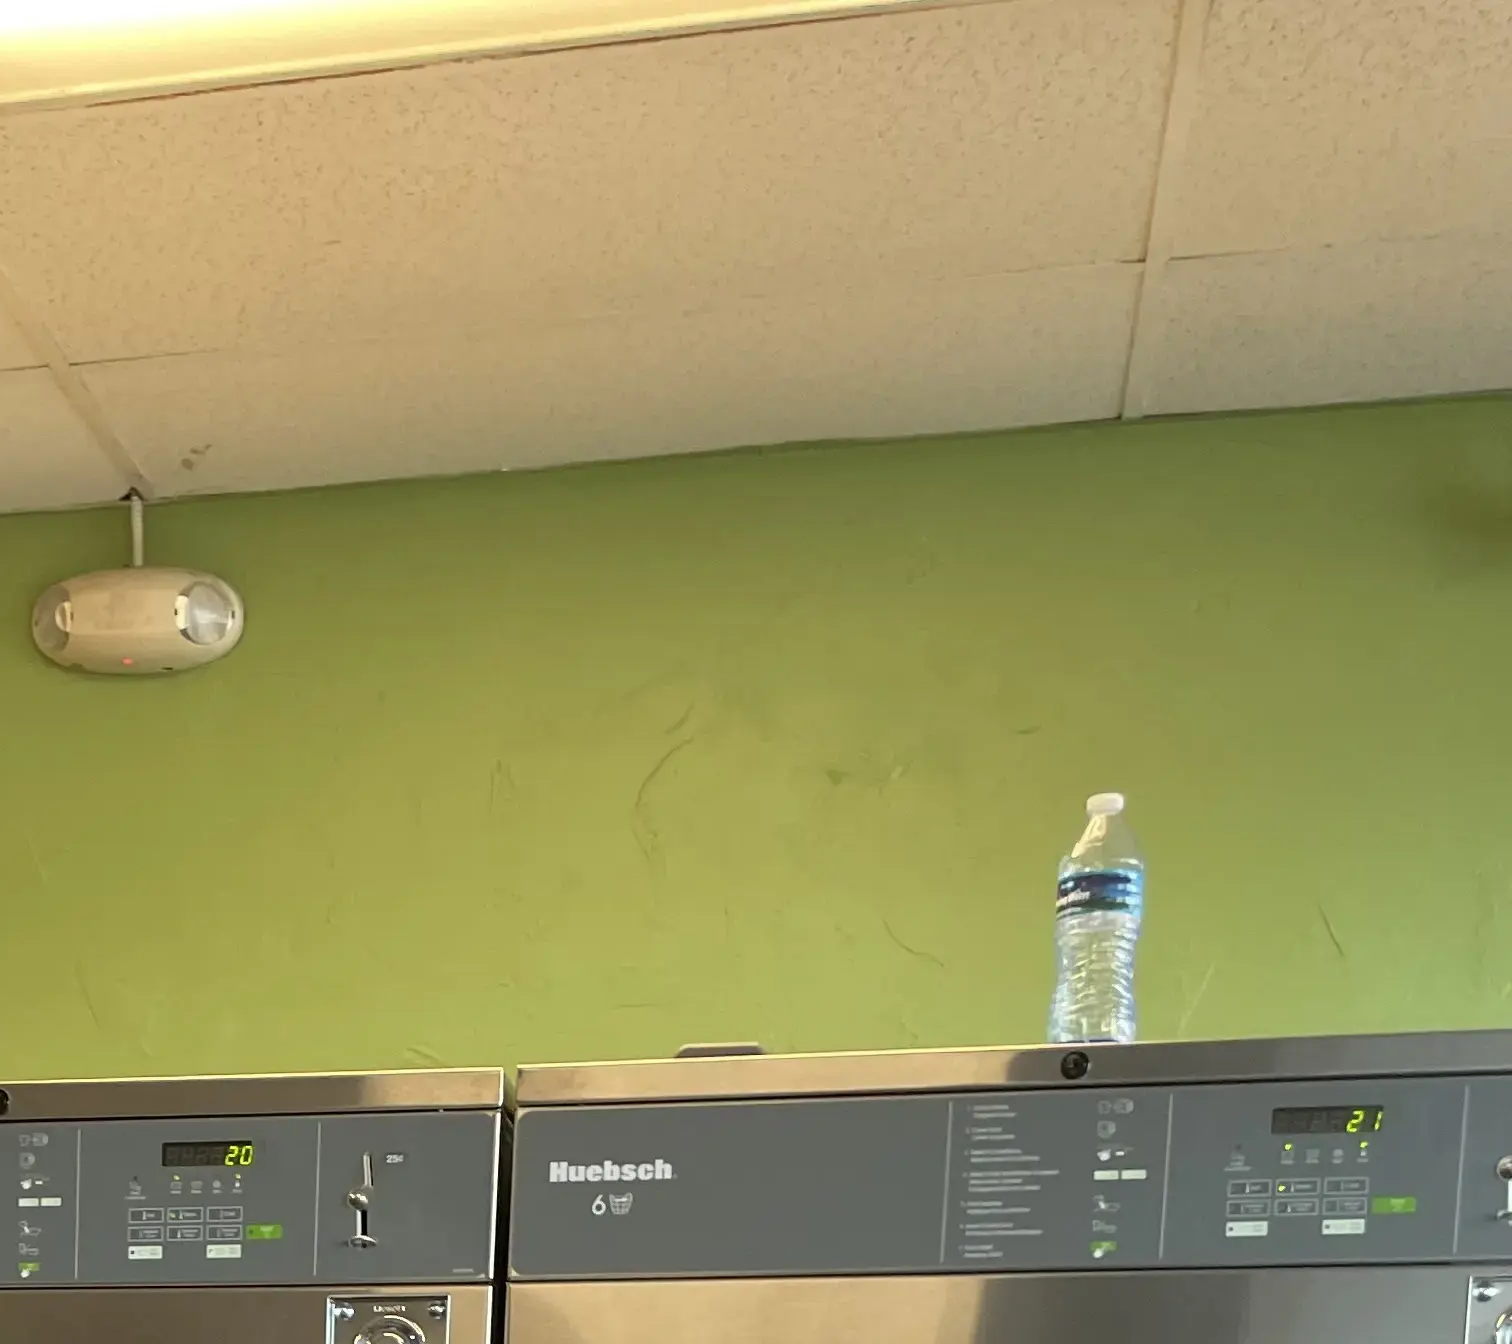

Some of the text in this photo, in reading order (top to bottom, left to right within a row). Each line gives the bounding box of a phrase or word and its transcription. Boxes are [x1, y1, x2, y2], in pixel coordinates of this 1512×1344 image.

[1346, 1110, 1384, 1133] 21
[224, 1145, 254, 1166] 20
[549, 1159, 673, 1182] Huebsch
[592, 1194, 606, 1215] 6
